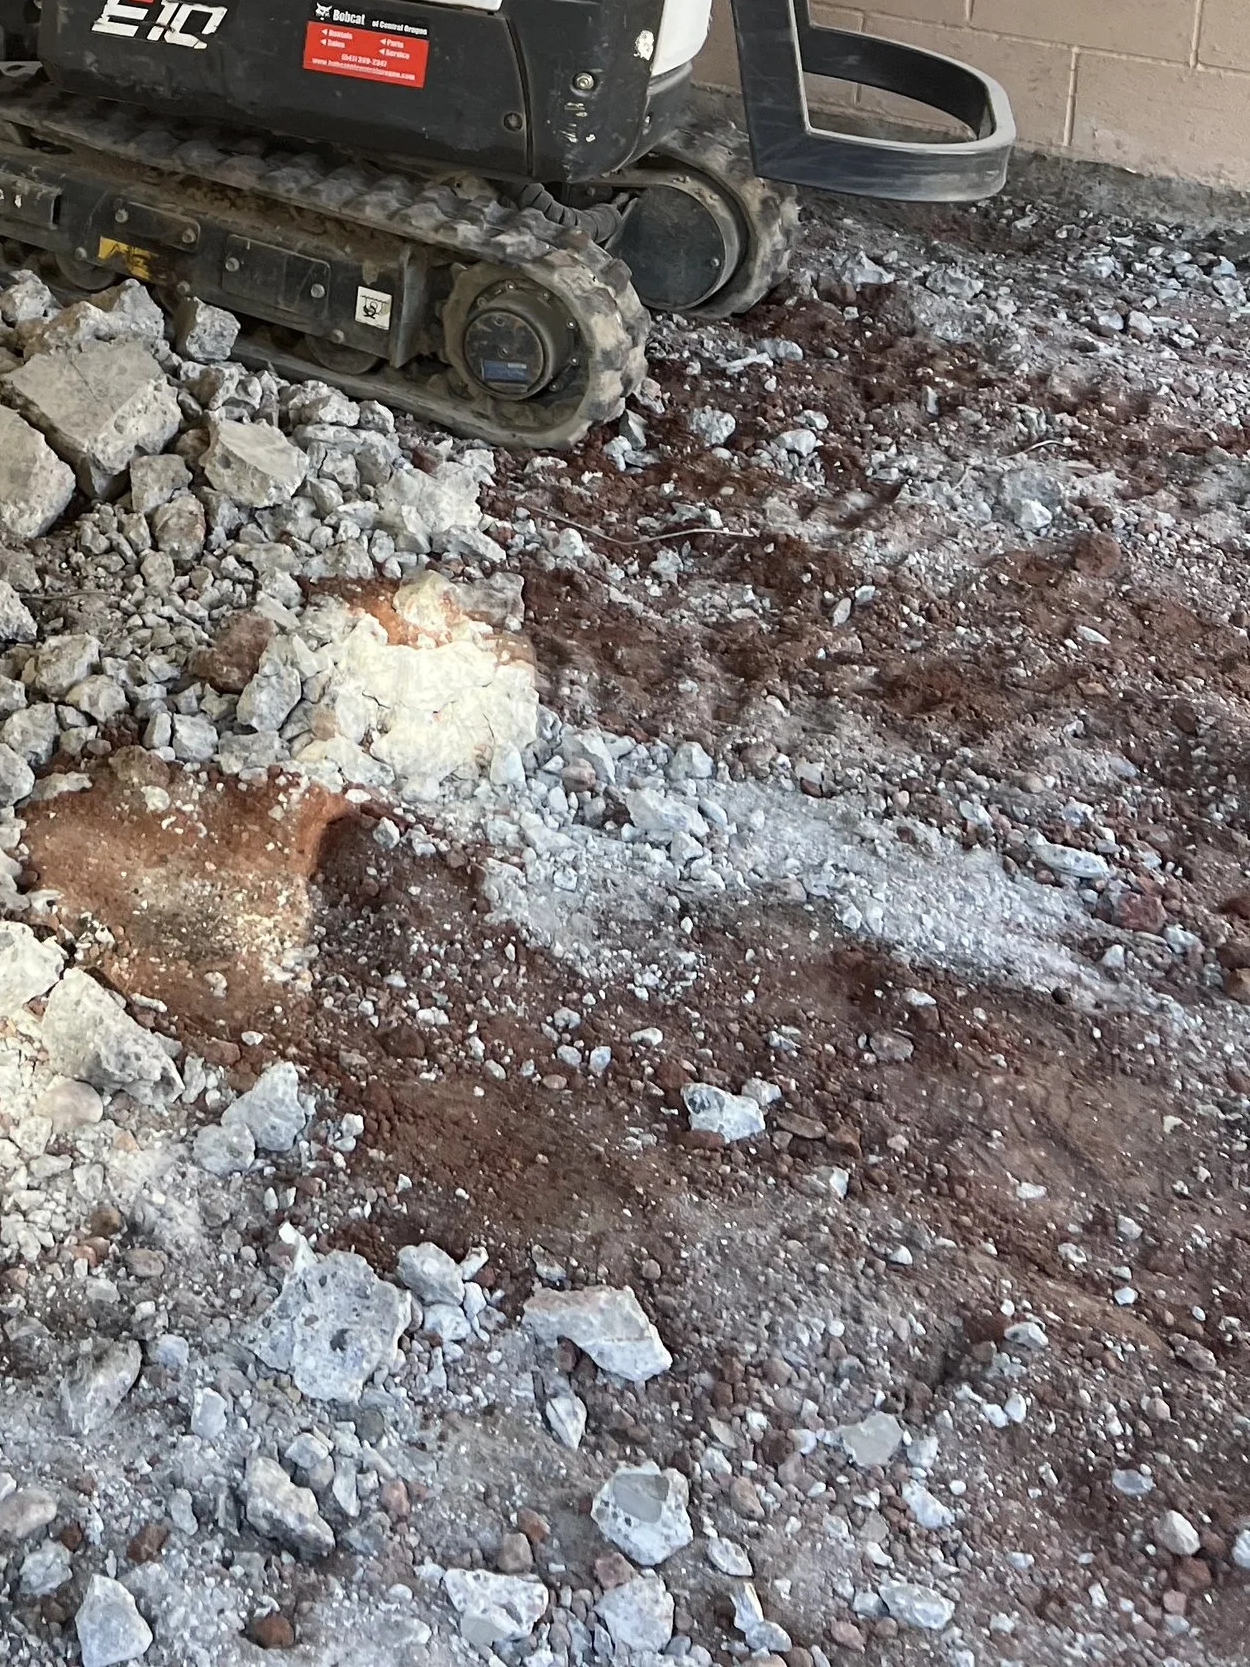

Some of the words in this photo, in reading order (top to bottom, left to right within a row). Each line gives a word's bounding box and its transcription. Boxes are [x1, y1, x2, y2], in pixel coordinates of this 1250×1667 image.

[332, 9, 366, 26] Bobcat
[372, 20, 380, 28] of
[379, 20, 404, 32] Central
[403, 24, 428, 36] Oregon
[386, 38, 405, 49] Parts
[385, 48, 411, 60] Service
